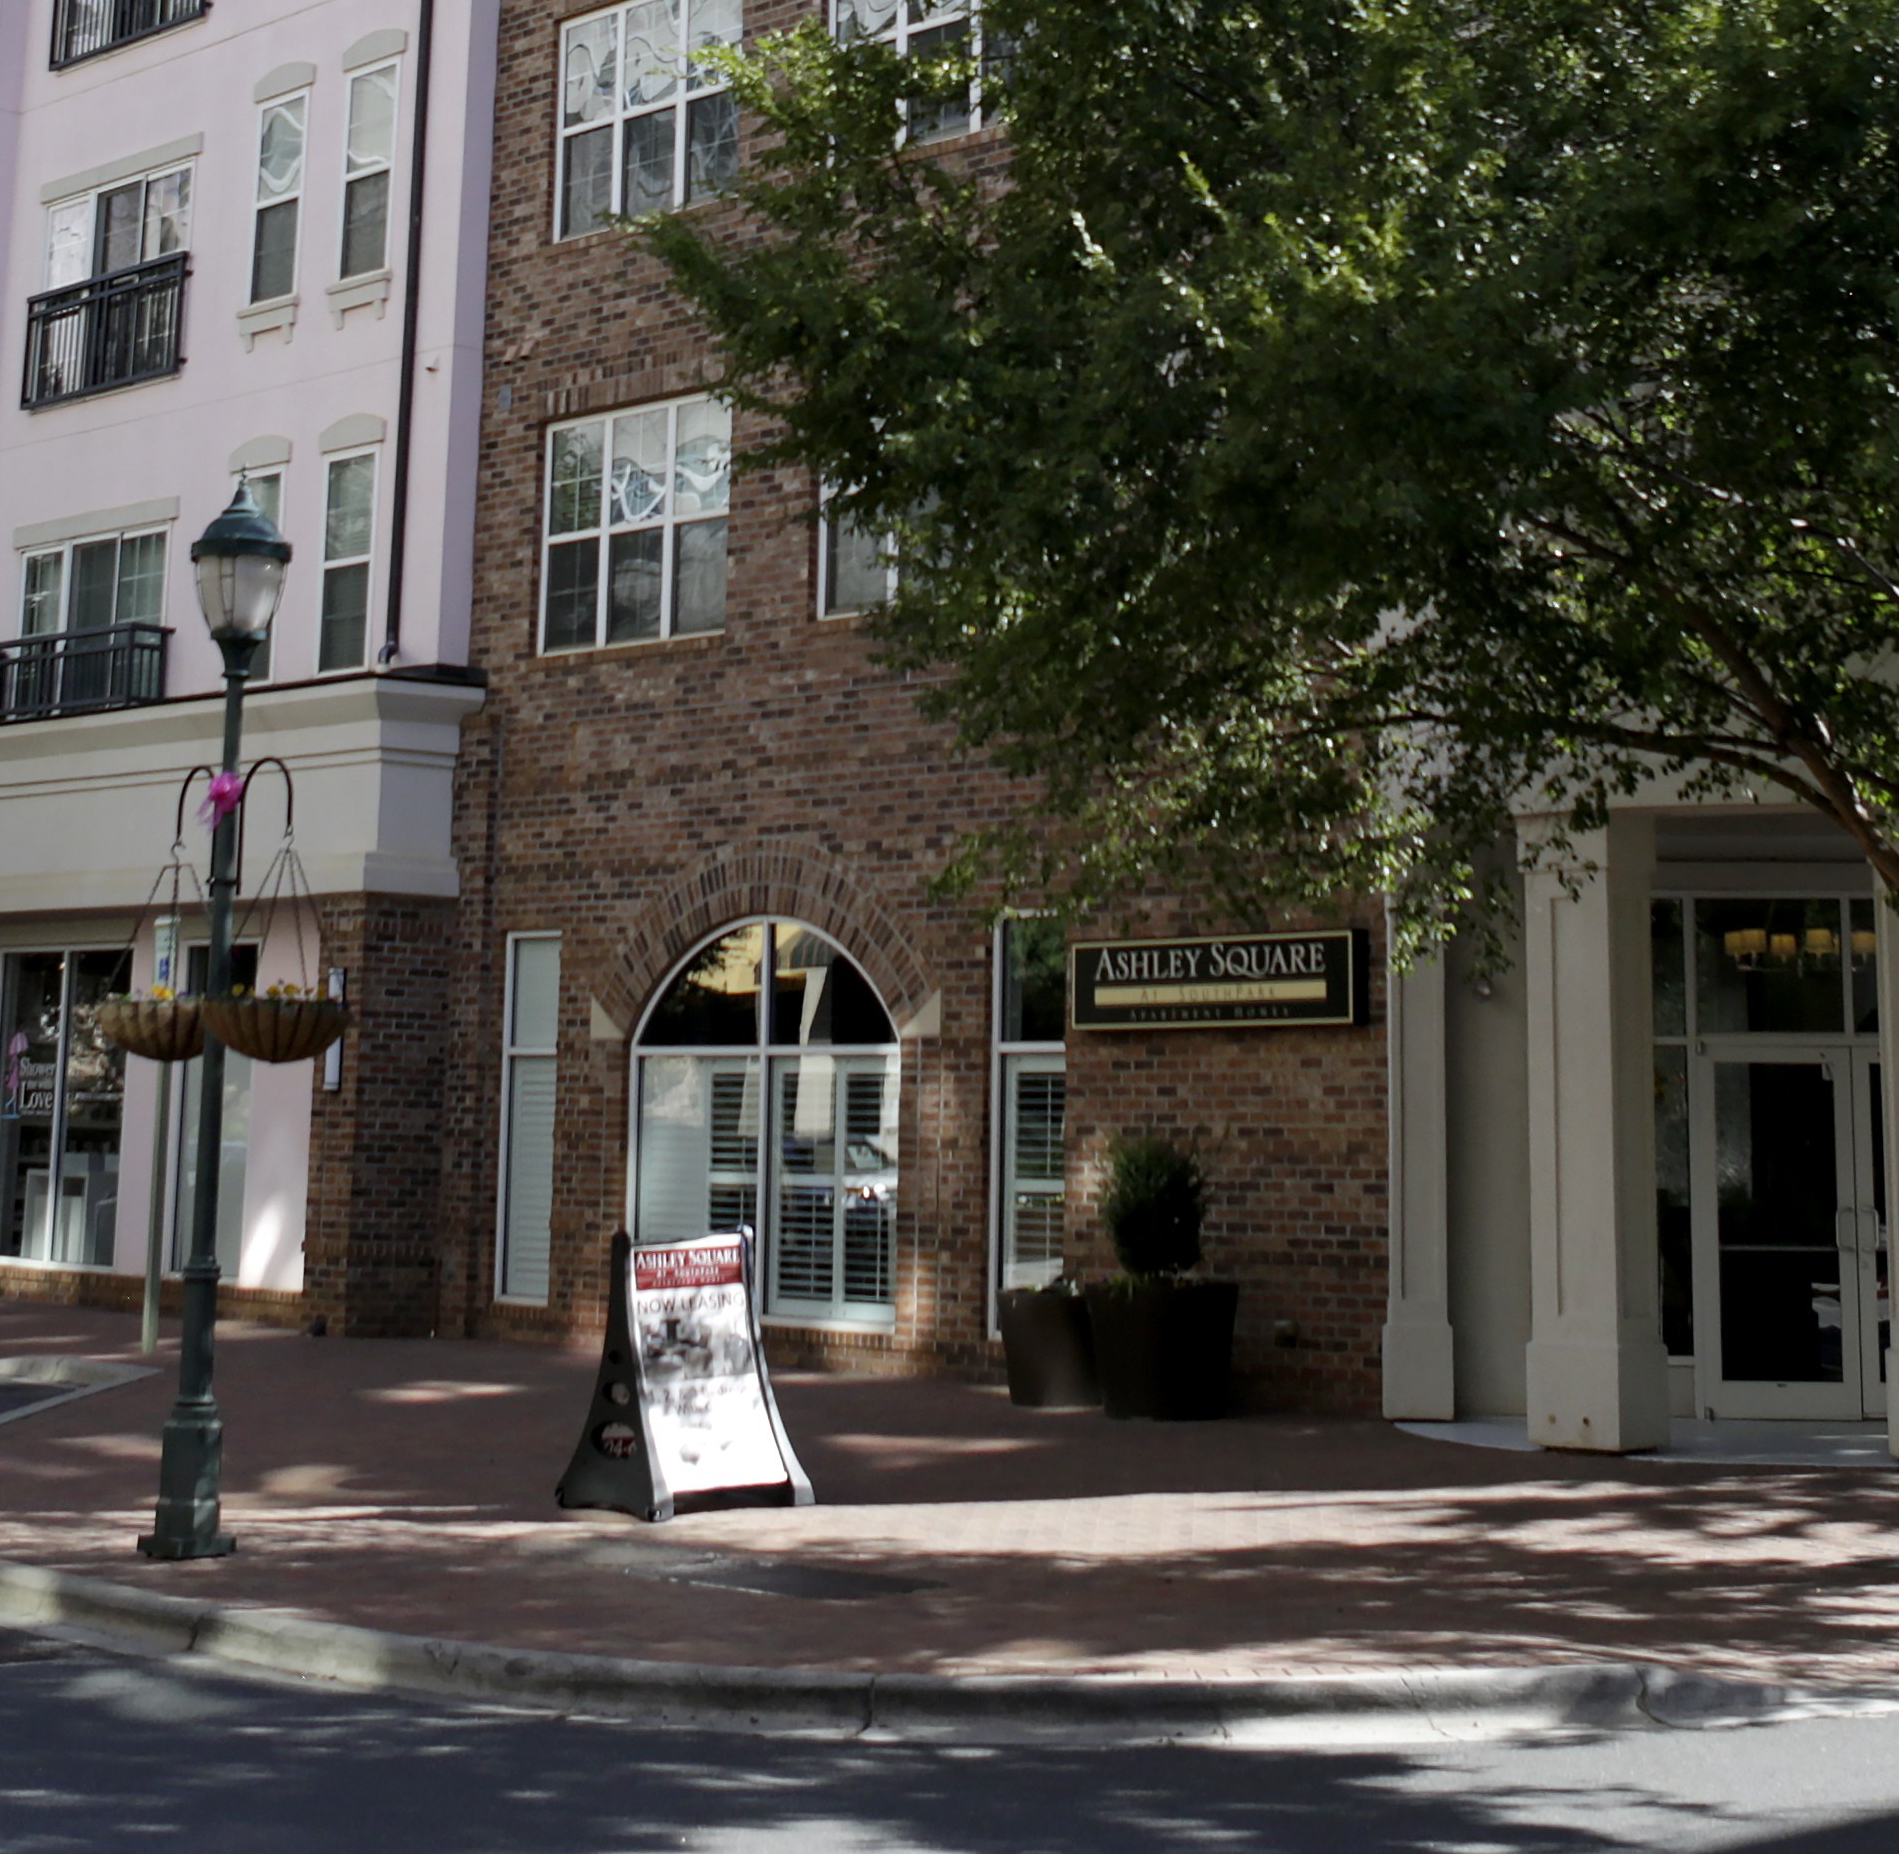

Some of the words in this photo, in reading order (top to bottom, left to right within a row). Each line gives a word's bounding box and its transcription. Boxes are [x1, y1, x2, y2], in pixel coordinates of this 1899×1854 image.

[1094, 947, 1203, 982] ASHLEY
[1209, 942, 1327, 979] SQUARE
[19, 1081, 54, 1109] Love
[636, 1250, 686, 1270] ASHLEY
[688, 1247, 741, 1266] SQUARE
[637, 1297, 676, 1314] NOW
[680, 1292, 745, 1311] LEASING
